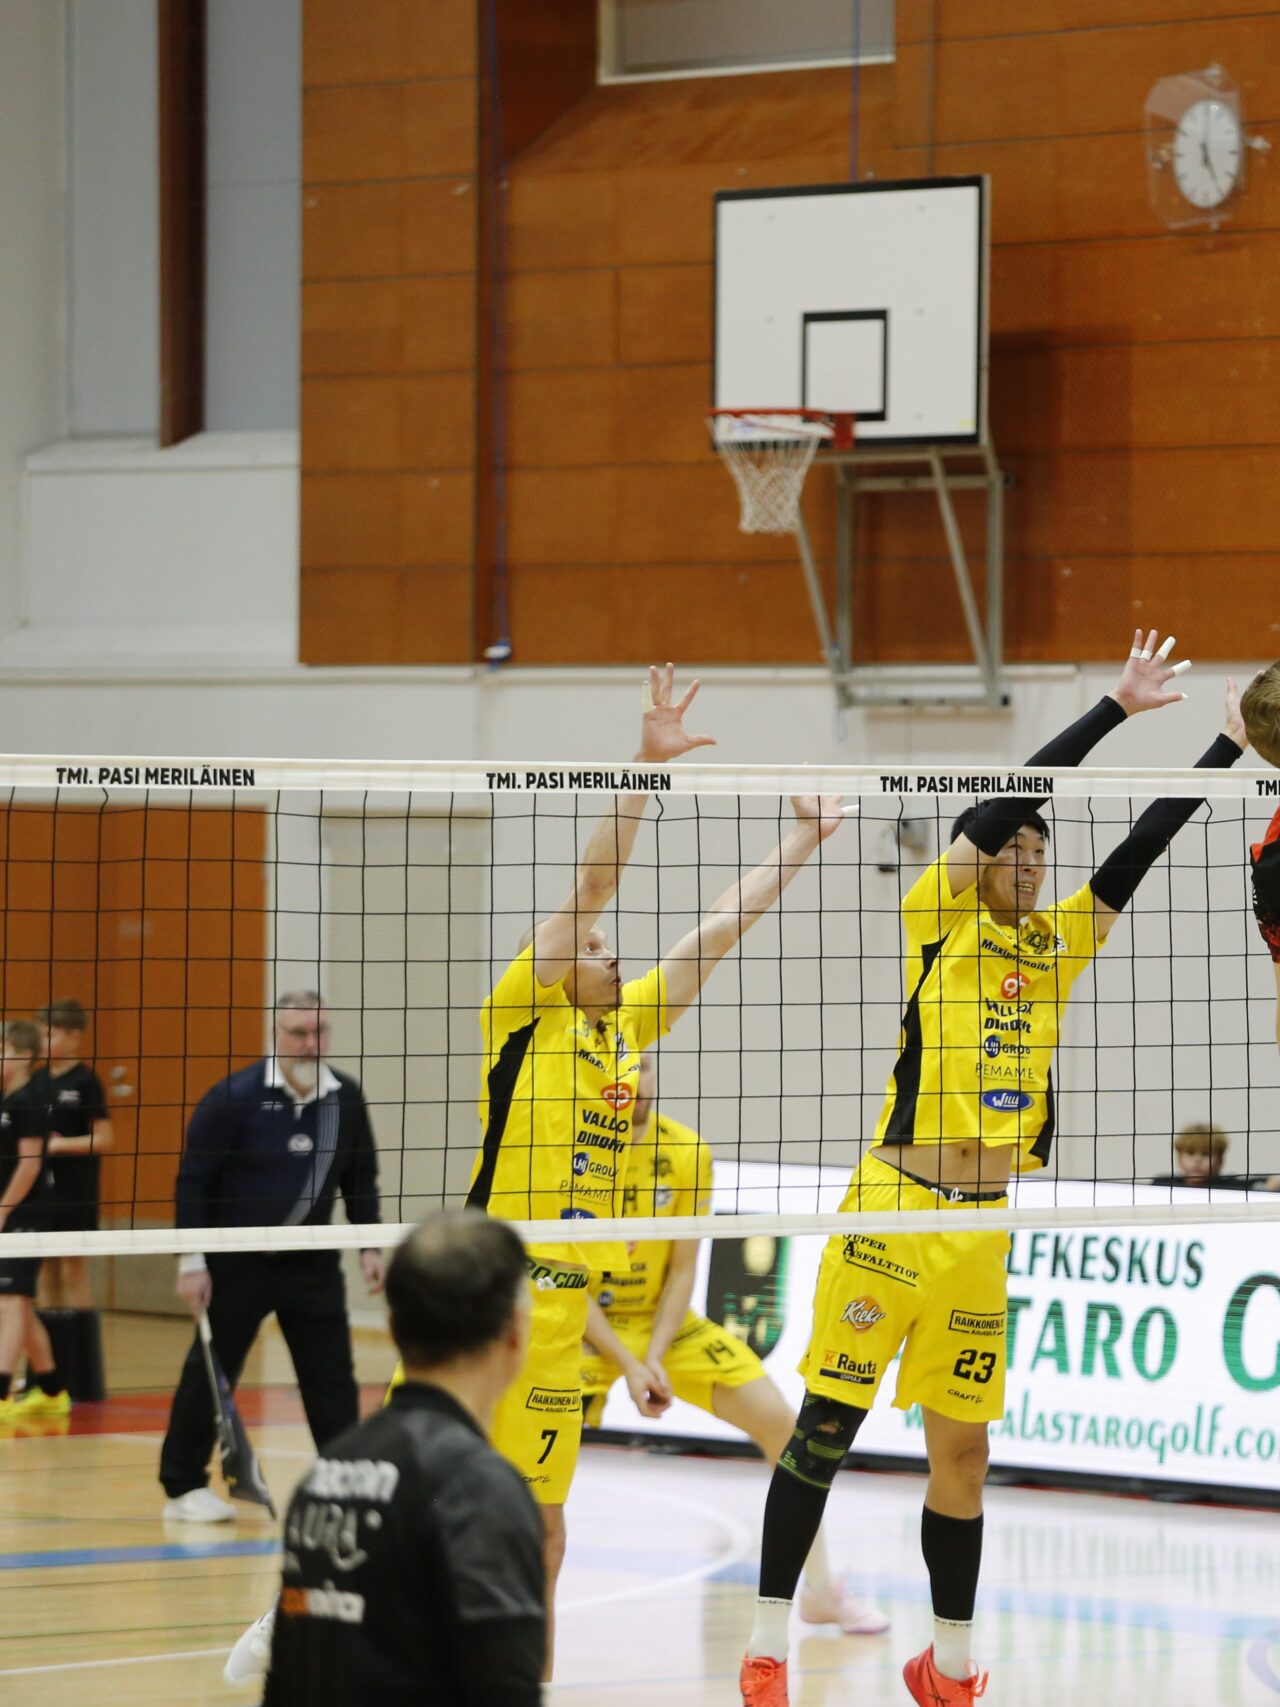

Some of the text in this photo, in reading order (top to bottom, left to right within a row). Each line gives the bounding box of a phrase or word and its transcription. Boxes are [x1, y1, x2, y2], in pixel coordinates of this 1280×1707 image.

[56, 764, 255, 787] TMI. PASI MERILÄINEN
[486, 769, 671, 791] TMI. PASI MERILÄINEN
[880, 773, 1054, 794] TMI. PASI MERILÄINEN
[704, 1339, 735, 1365] 14
[953, 1348, 997, 1384] 23
[537, 1429, 558, 1464] 7
